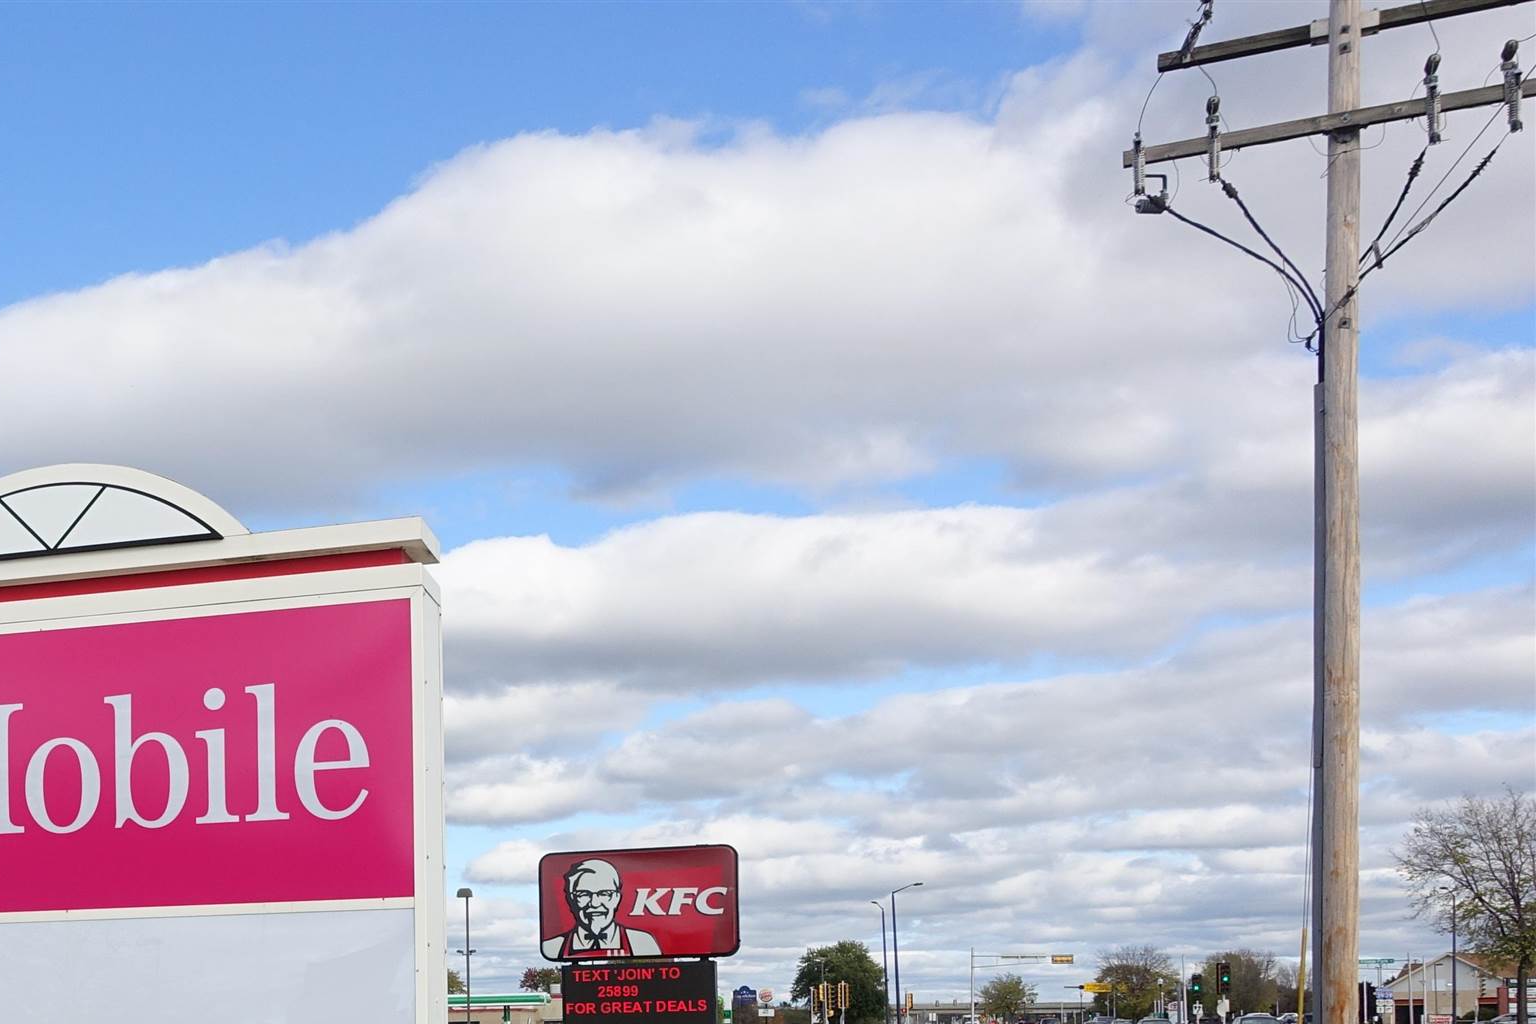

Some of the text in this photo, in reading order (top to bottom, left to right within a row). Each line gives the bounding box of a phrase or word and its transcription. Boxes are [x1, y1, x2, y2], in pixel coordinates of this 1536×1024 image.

[628, 886, 728, 916] KFC
[572, 969, 610, 983] TEXT
[659, 966, 681, 980] TO
[597, 984, 639, 998] 25899
[565, 999, 708, 1015] FOR GREAT DEALS
